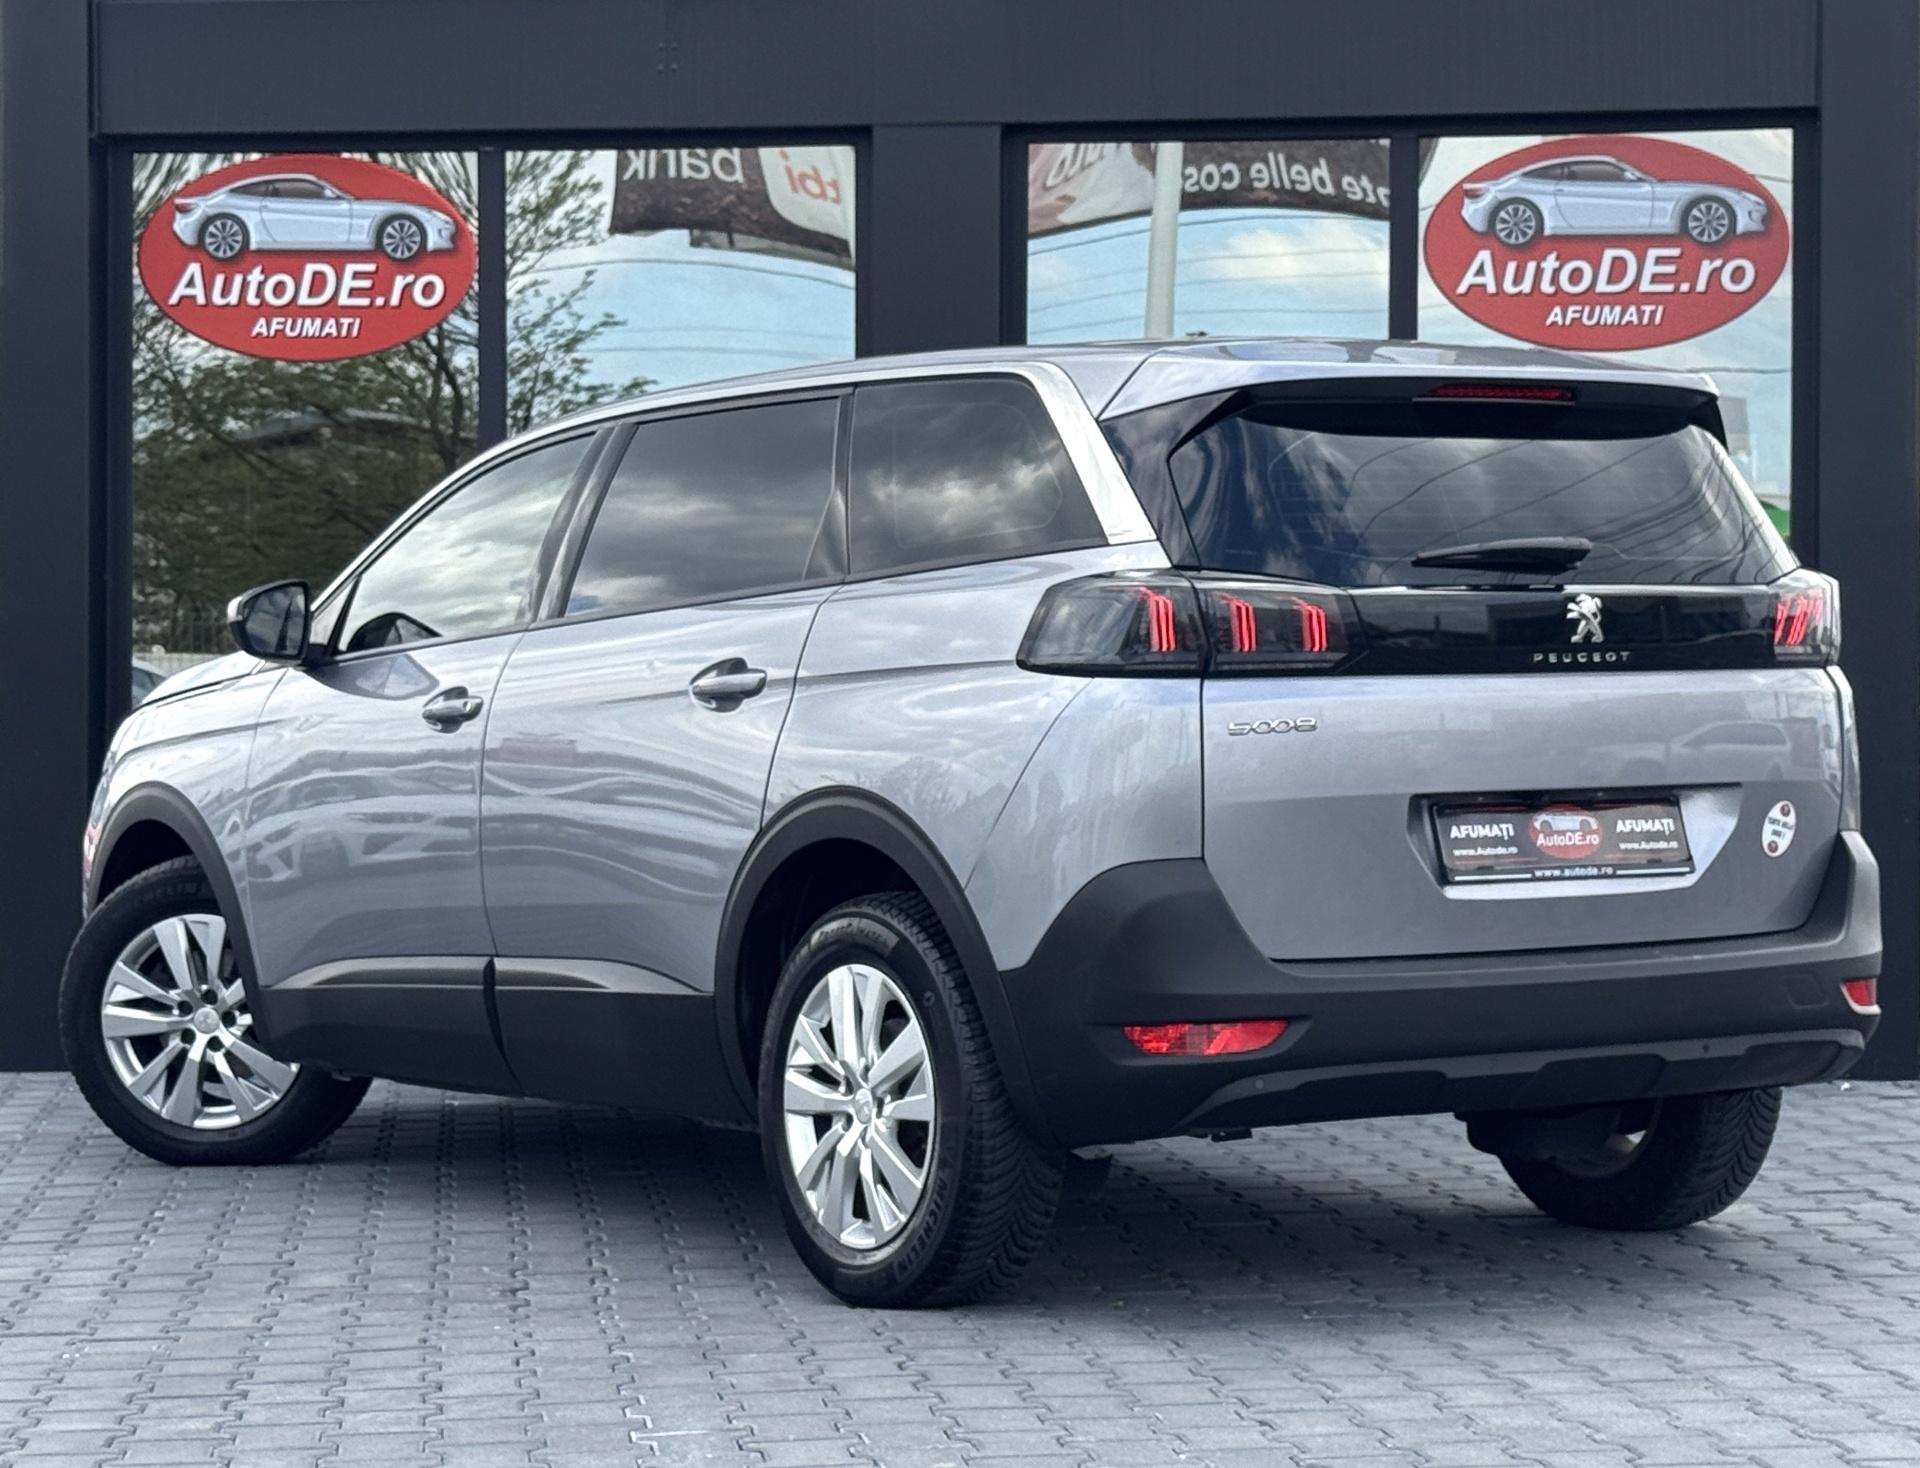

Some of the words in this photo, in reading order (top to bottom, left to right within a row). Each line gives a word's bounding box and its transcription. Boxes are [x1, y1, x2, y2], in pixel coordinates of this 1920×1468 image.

[1455, 246, 1757, 296] AutoDE.ro
[168, 261, 446, 308] AutoDE.ro
[1545, 303, 1664, 327] AFUMATI
[250, 316, 361, 338] AFUMATI
[1533, 651, 1632, 664] PEUGEOT
[1227, 716, 1318, 736] 5008
[1536, 831, 1600, 848] AutoDE.ro
